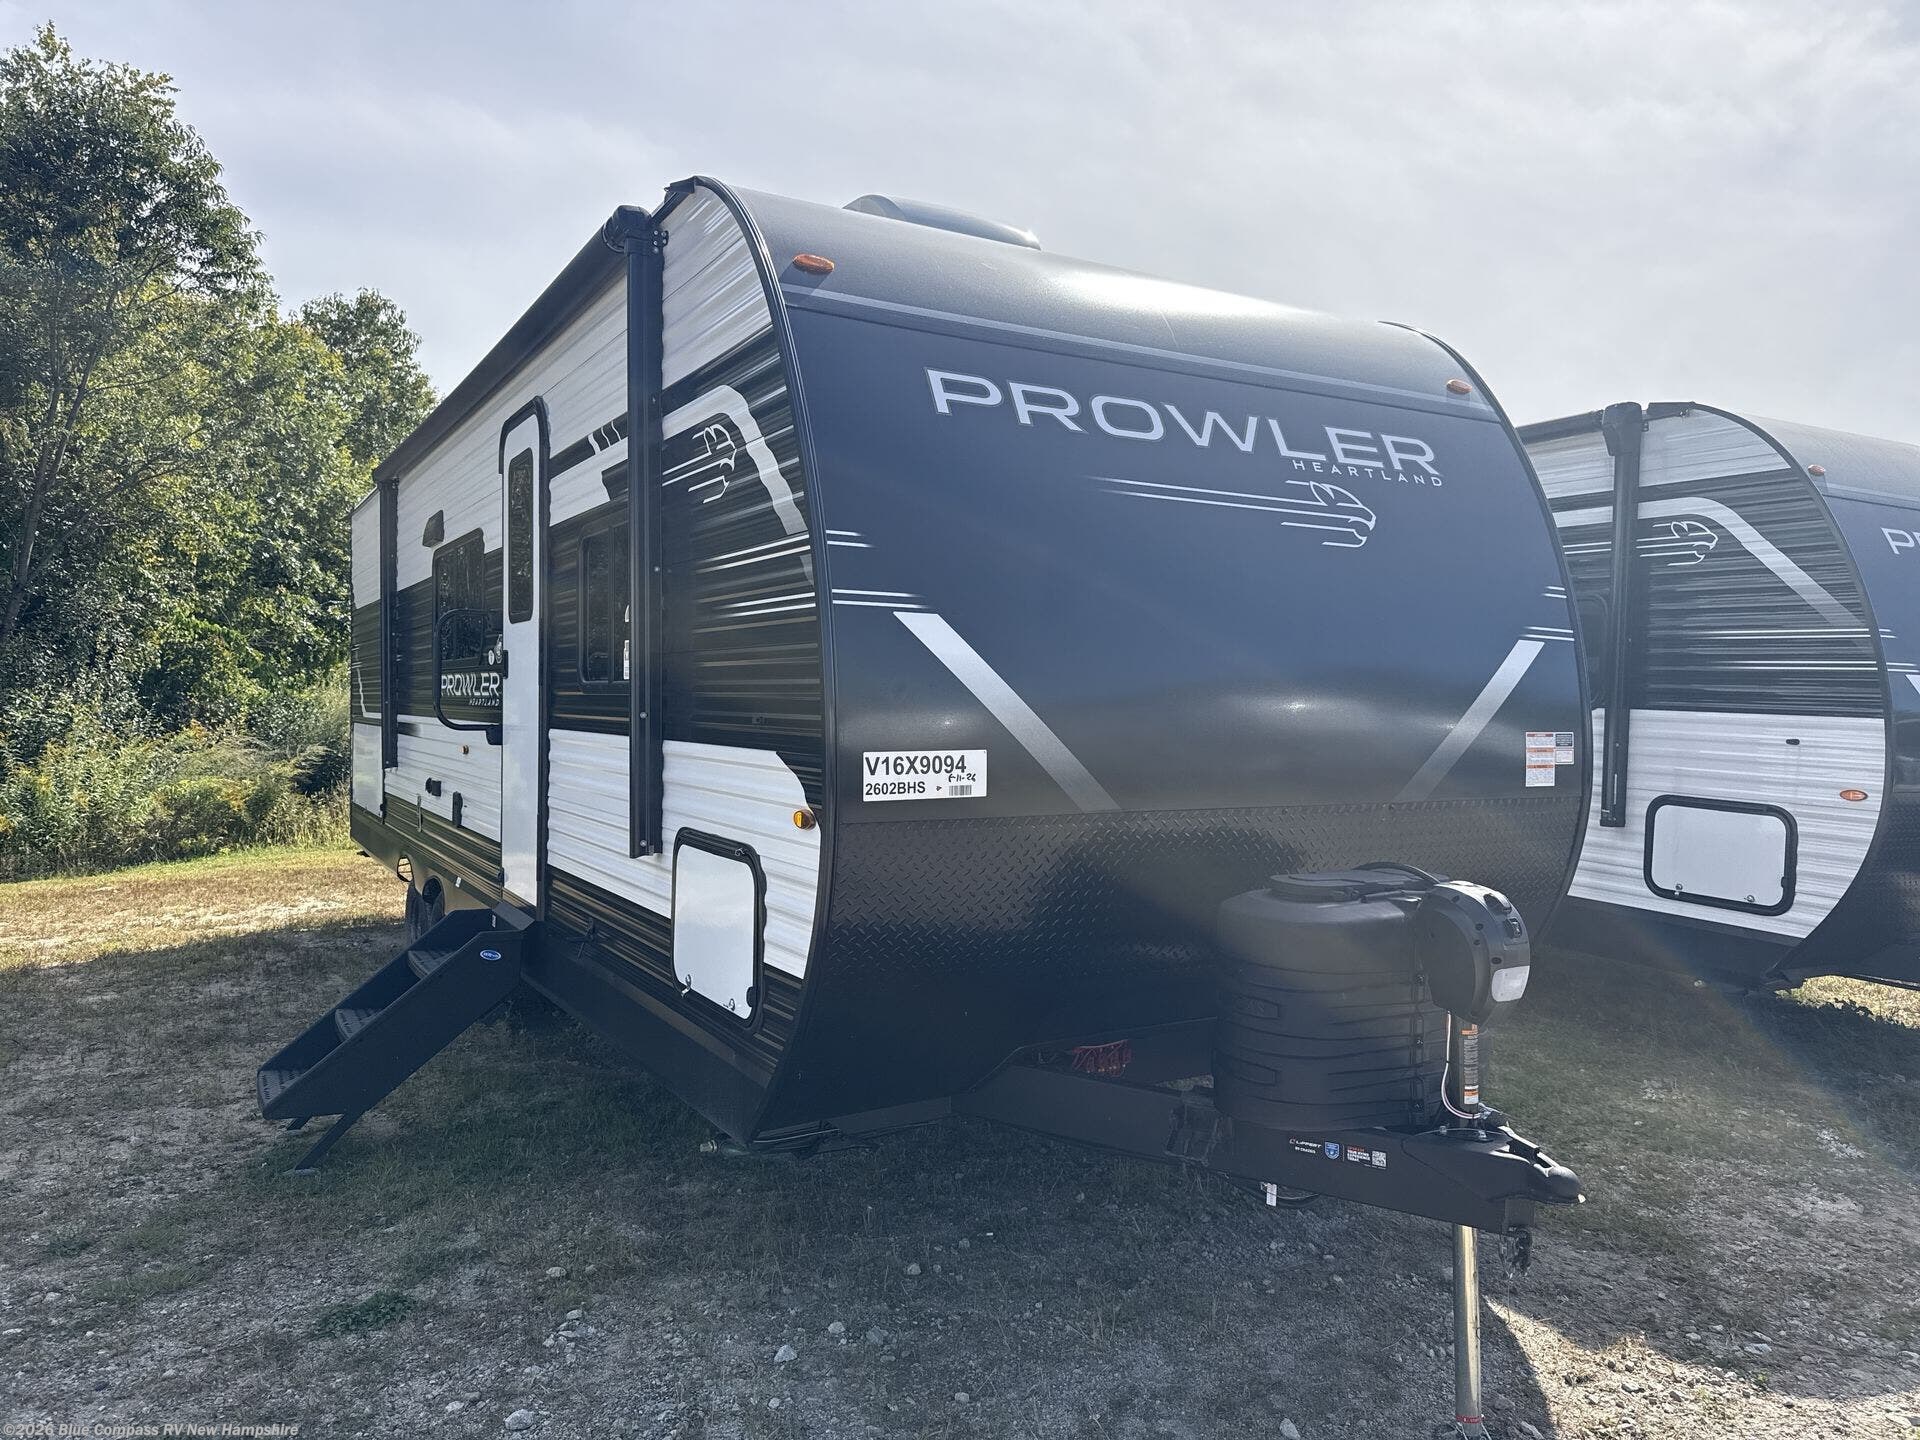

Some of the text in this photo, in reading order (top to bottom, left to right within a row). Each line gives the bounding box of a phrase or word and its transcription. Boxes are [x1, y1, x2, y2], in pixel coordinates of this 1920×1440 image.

[925, 367, 1440, 475] PROWLER
[1293, 460, 1443, 487] HEARTLAND
[441, 672, 500, 696] PROWLER
[865, 755, 967, 775] V16X9094
[865, 781, 926, 796] 2602BHS
